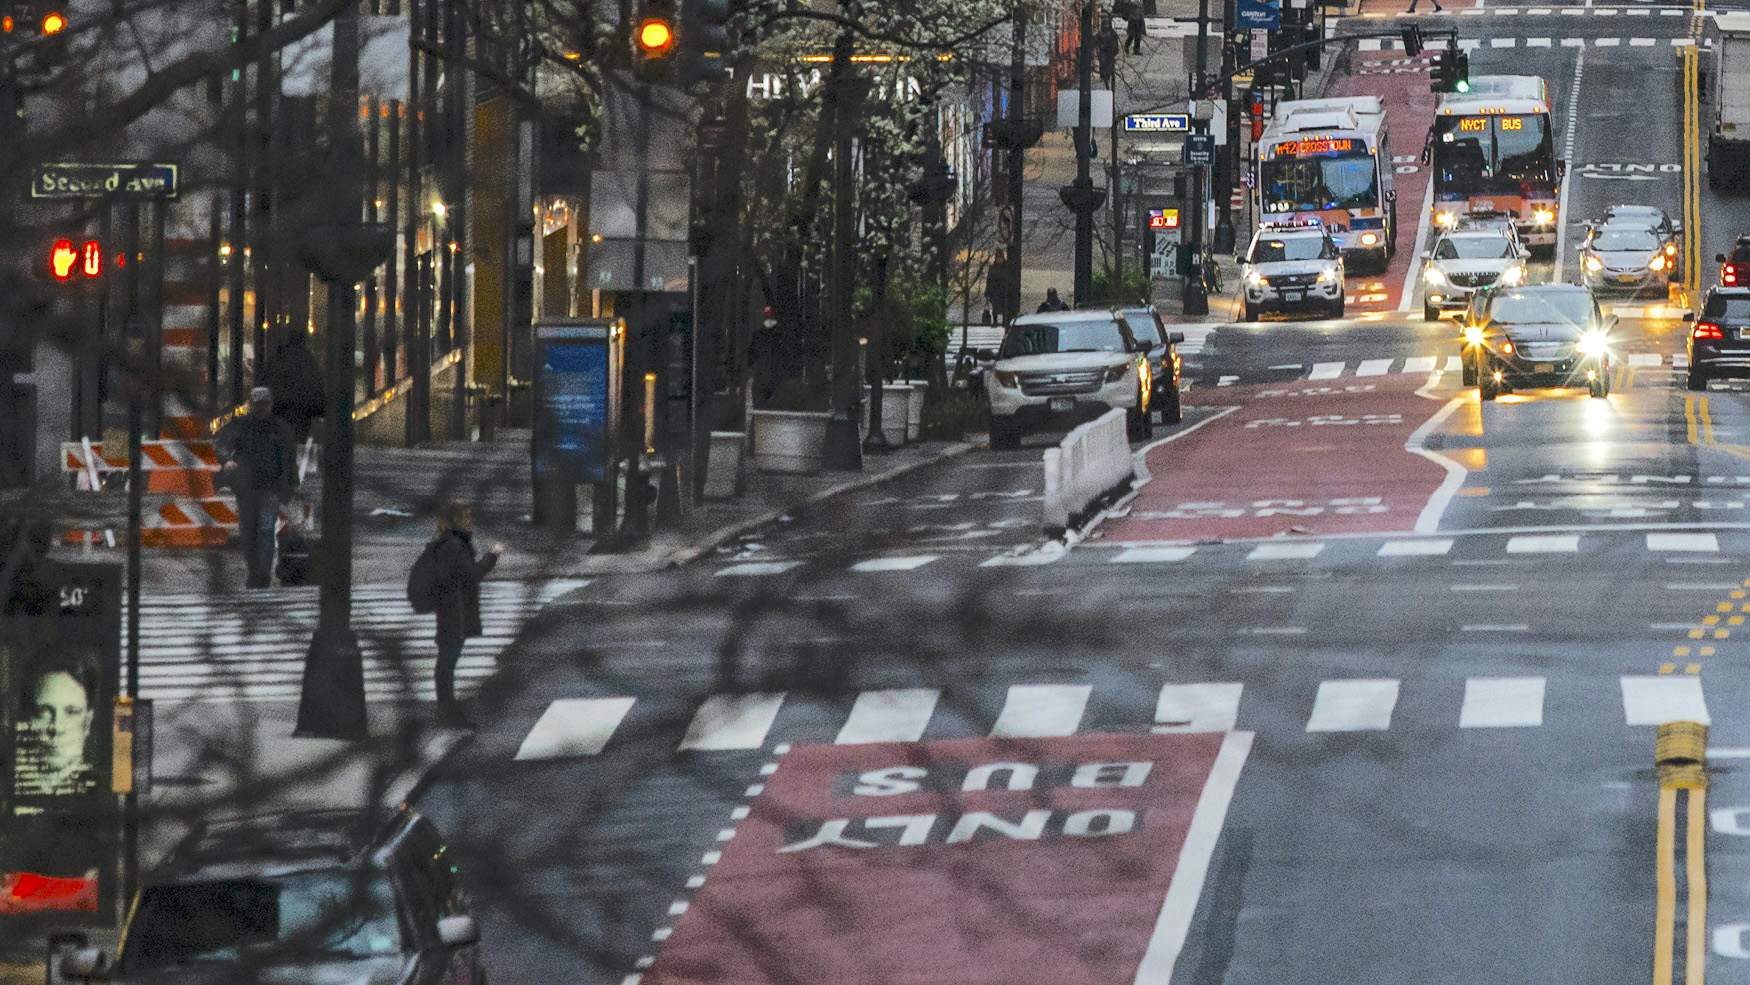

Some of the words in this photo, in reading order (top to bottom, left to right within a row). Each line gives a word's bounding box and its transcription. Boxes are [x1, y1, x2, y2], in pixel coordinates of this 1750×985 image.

[1133, 117, 1161, 128] Third
[1162, 118, 1181, 128] Ave
[1460, 118, 1487, 131] NYCT
[1501, 117, 1522, 130] BUS
[1299, 139, 1352, 153] CROSSTOWN
[851, 761, 1155, 797] BUS
[776, 808, 1137, 853] ONLY
